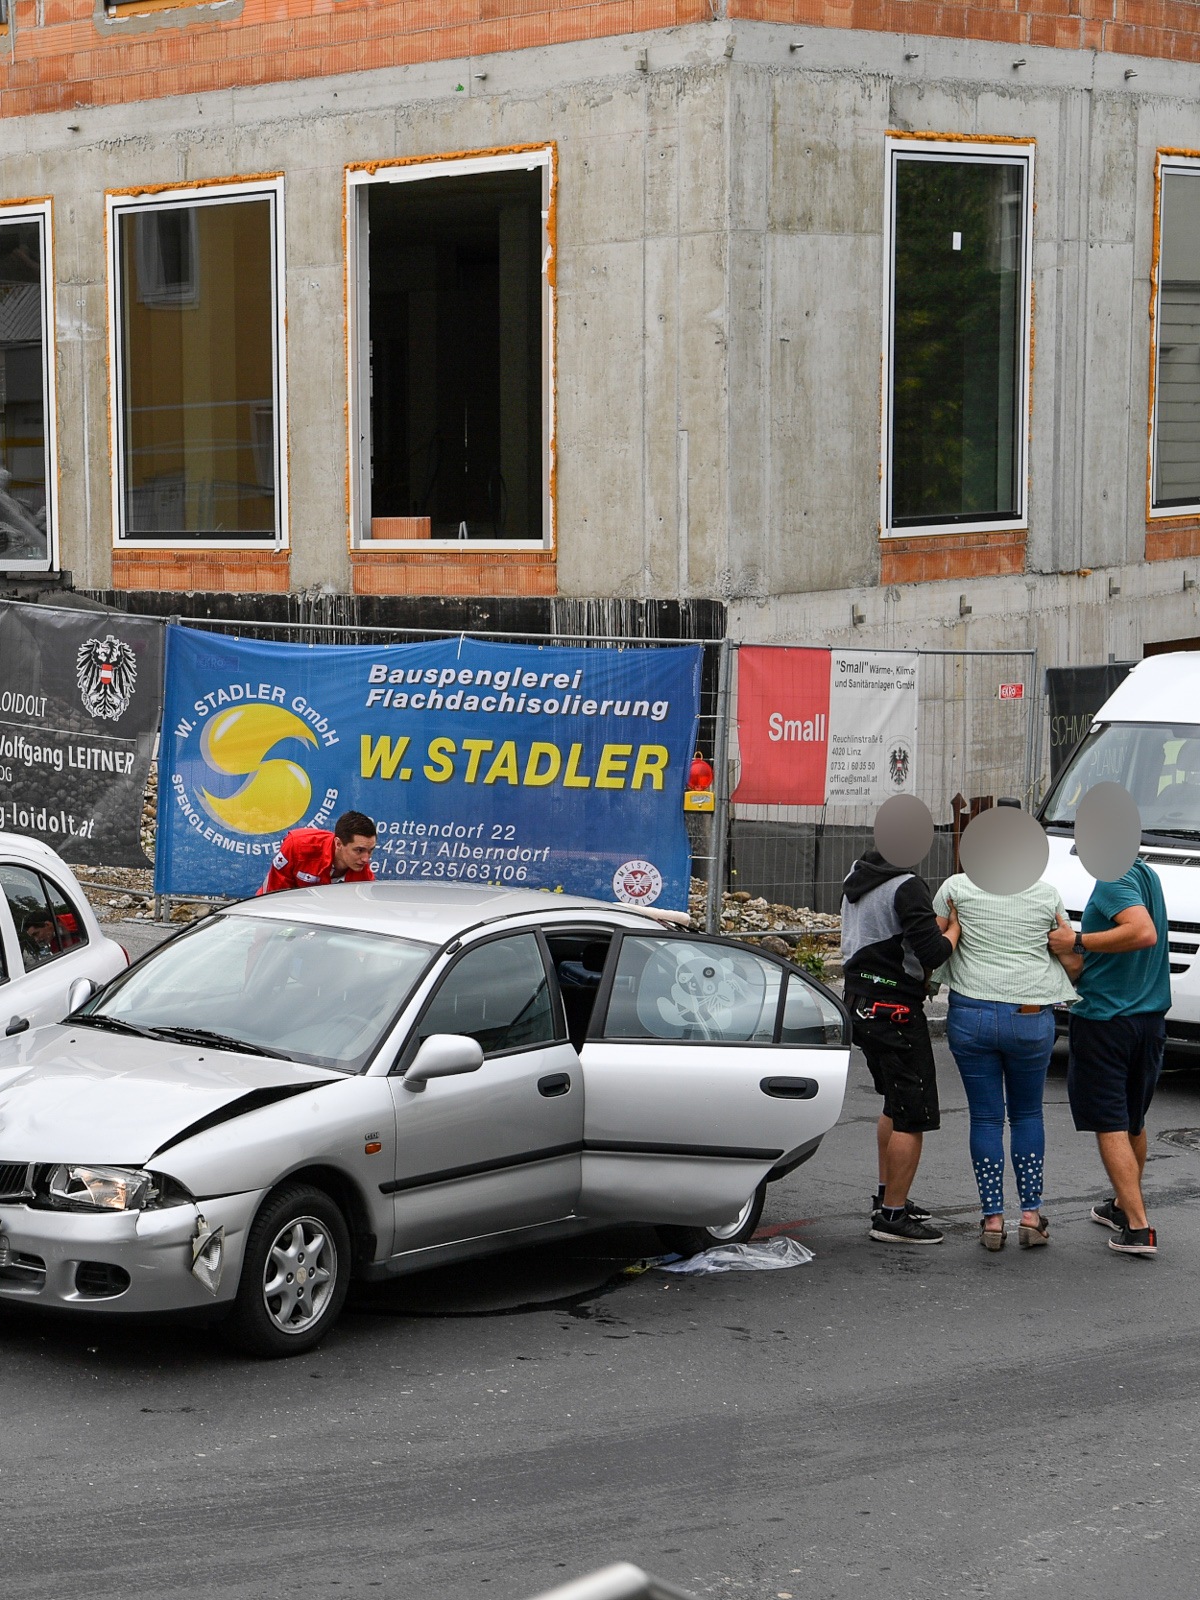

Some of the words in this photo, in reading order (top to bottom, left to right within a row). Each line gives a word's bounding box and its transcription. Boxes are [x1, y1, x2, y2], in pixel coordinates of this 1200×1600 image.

[367, 664, 583, 691] Bauspenglerei
[836, 660, 869, 674] "Small"
[835, 679, 847, 688] und
[848, 679, 894, 691] Sanitäranlagen
[896, 680, 915, 690] GmbH
[174, 718, 197, 739] W.
[194, 683, 286, 717] STADLER
[291, 696, 340, 747] GmbH
[365, 688, 670, 722] Flachdachisolierung
[768, 711, 826, 742] Small
[1051, 713, 1094, 747] SCHMI
[832, 735, 878, 744] Reuchlinstraße
[68, 745, 135, 775] LEITNER
[831, 747, 846, 756] 4020
[846, 747, 861, 756] Linz
[423, 737, 670, 790] STADLER
[830, 761, 845, 770] 0732
[851, 761, 858, 770] 60
[867, 761, 875, 770] 50
[830, 774, 878, 785] office@small.at
[830, 786, 870, 795] www.small.at
[368, 816, 484, 839] pattendorf
[490, 824, 516, 841] 22
[436, 842, 551, 863] Alberndorf
[369, 859, 528, 881] el.07235/63106
[617, 862, 659, 880] MEISTER
